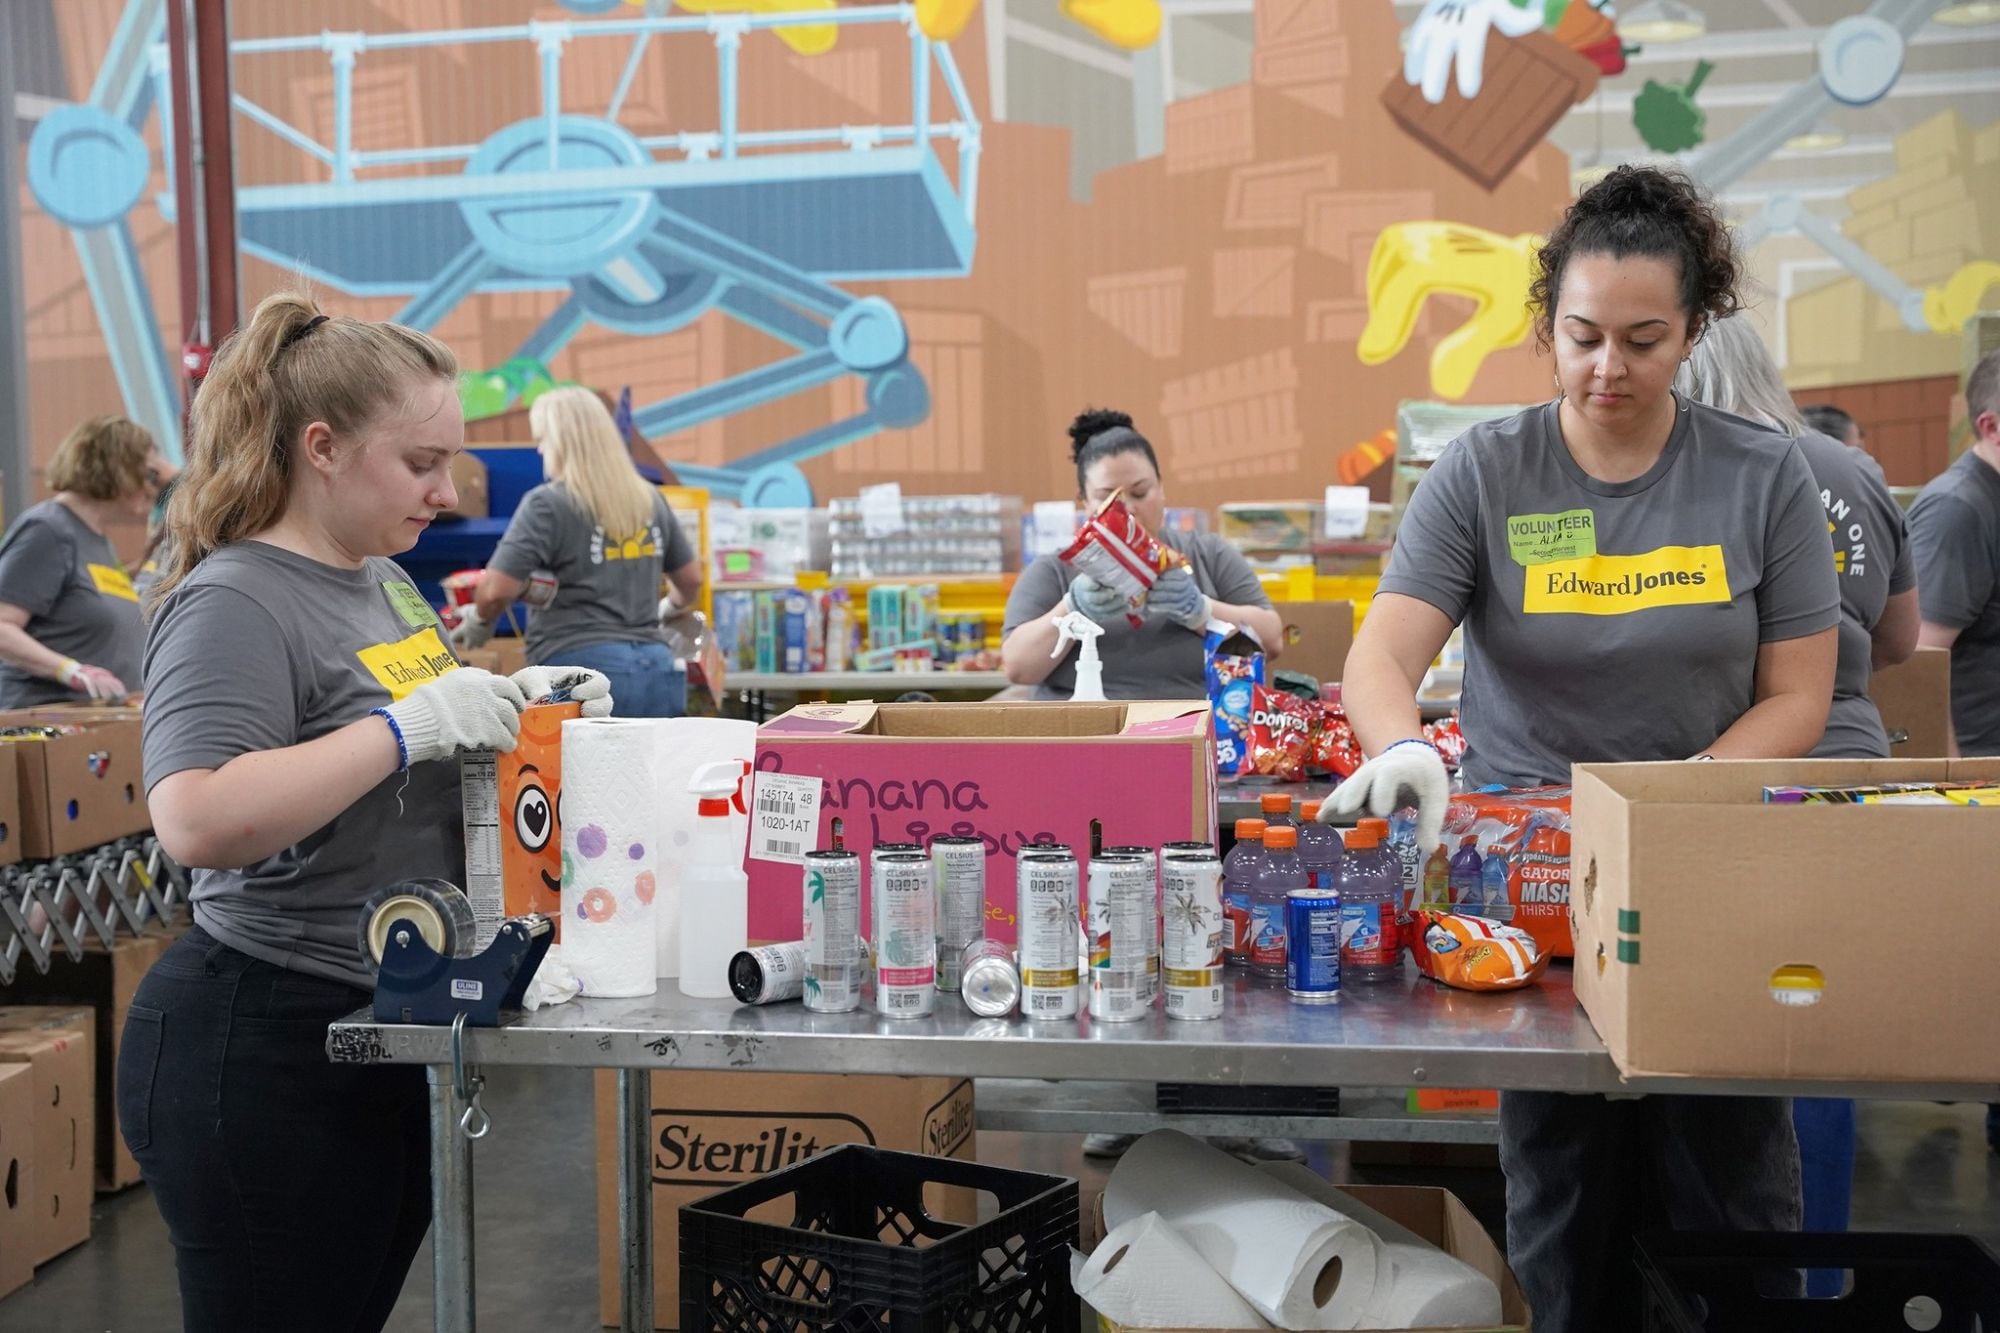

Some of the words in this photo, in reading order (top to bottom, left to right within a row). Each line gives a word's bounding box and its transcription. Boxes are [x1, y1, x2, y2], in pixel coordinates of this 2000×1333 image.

[1510, 515, 1592, 535] VOLUNTEER
[1848, 524, 1866, 577] ONE
[761, 788, 794, 803] 145174
[800, 793, 813, 805] 48
[761, 816, 811, 833] 1020-1AT
[945, 852, 974, 860] CELSIUS
[1520, 904, 1561, 917] THIRST
